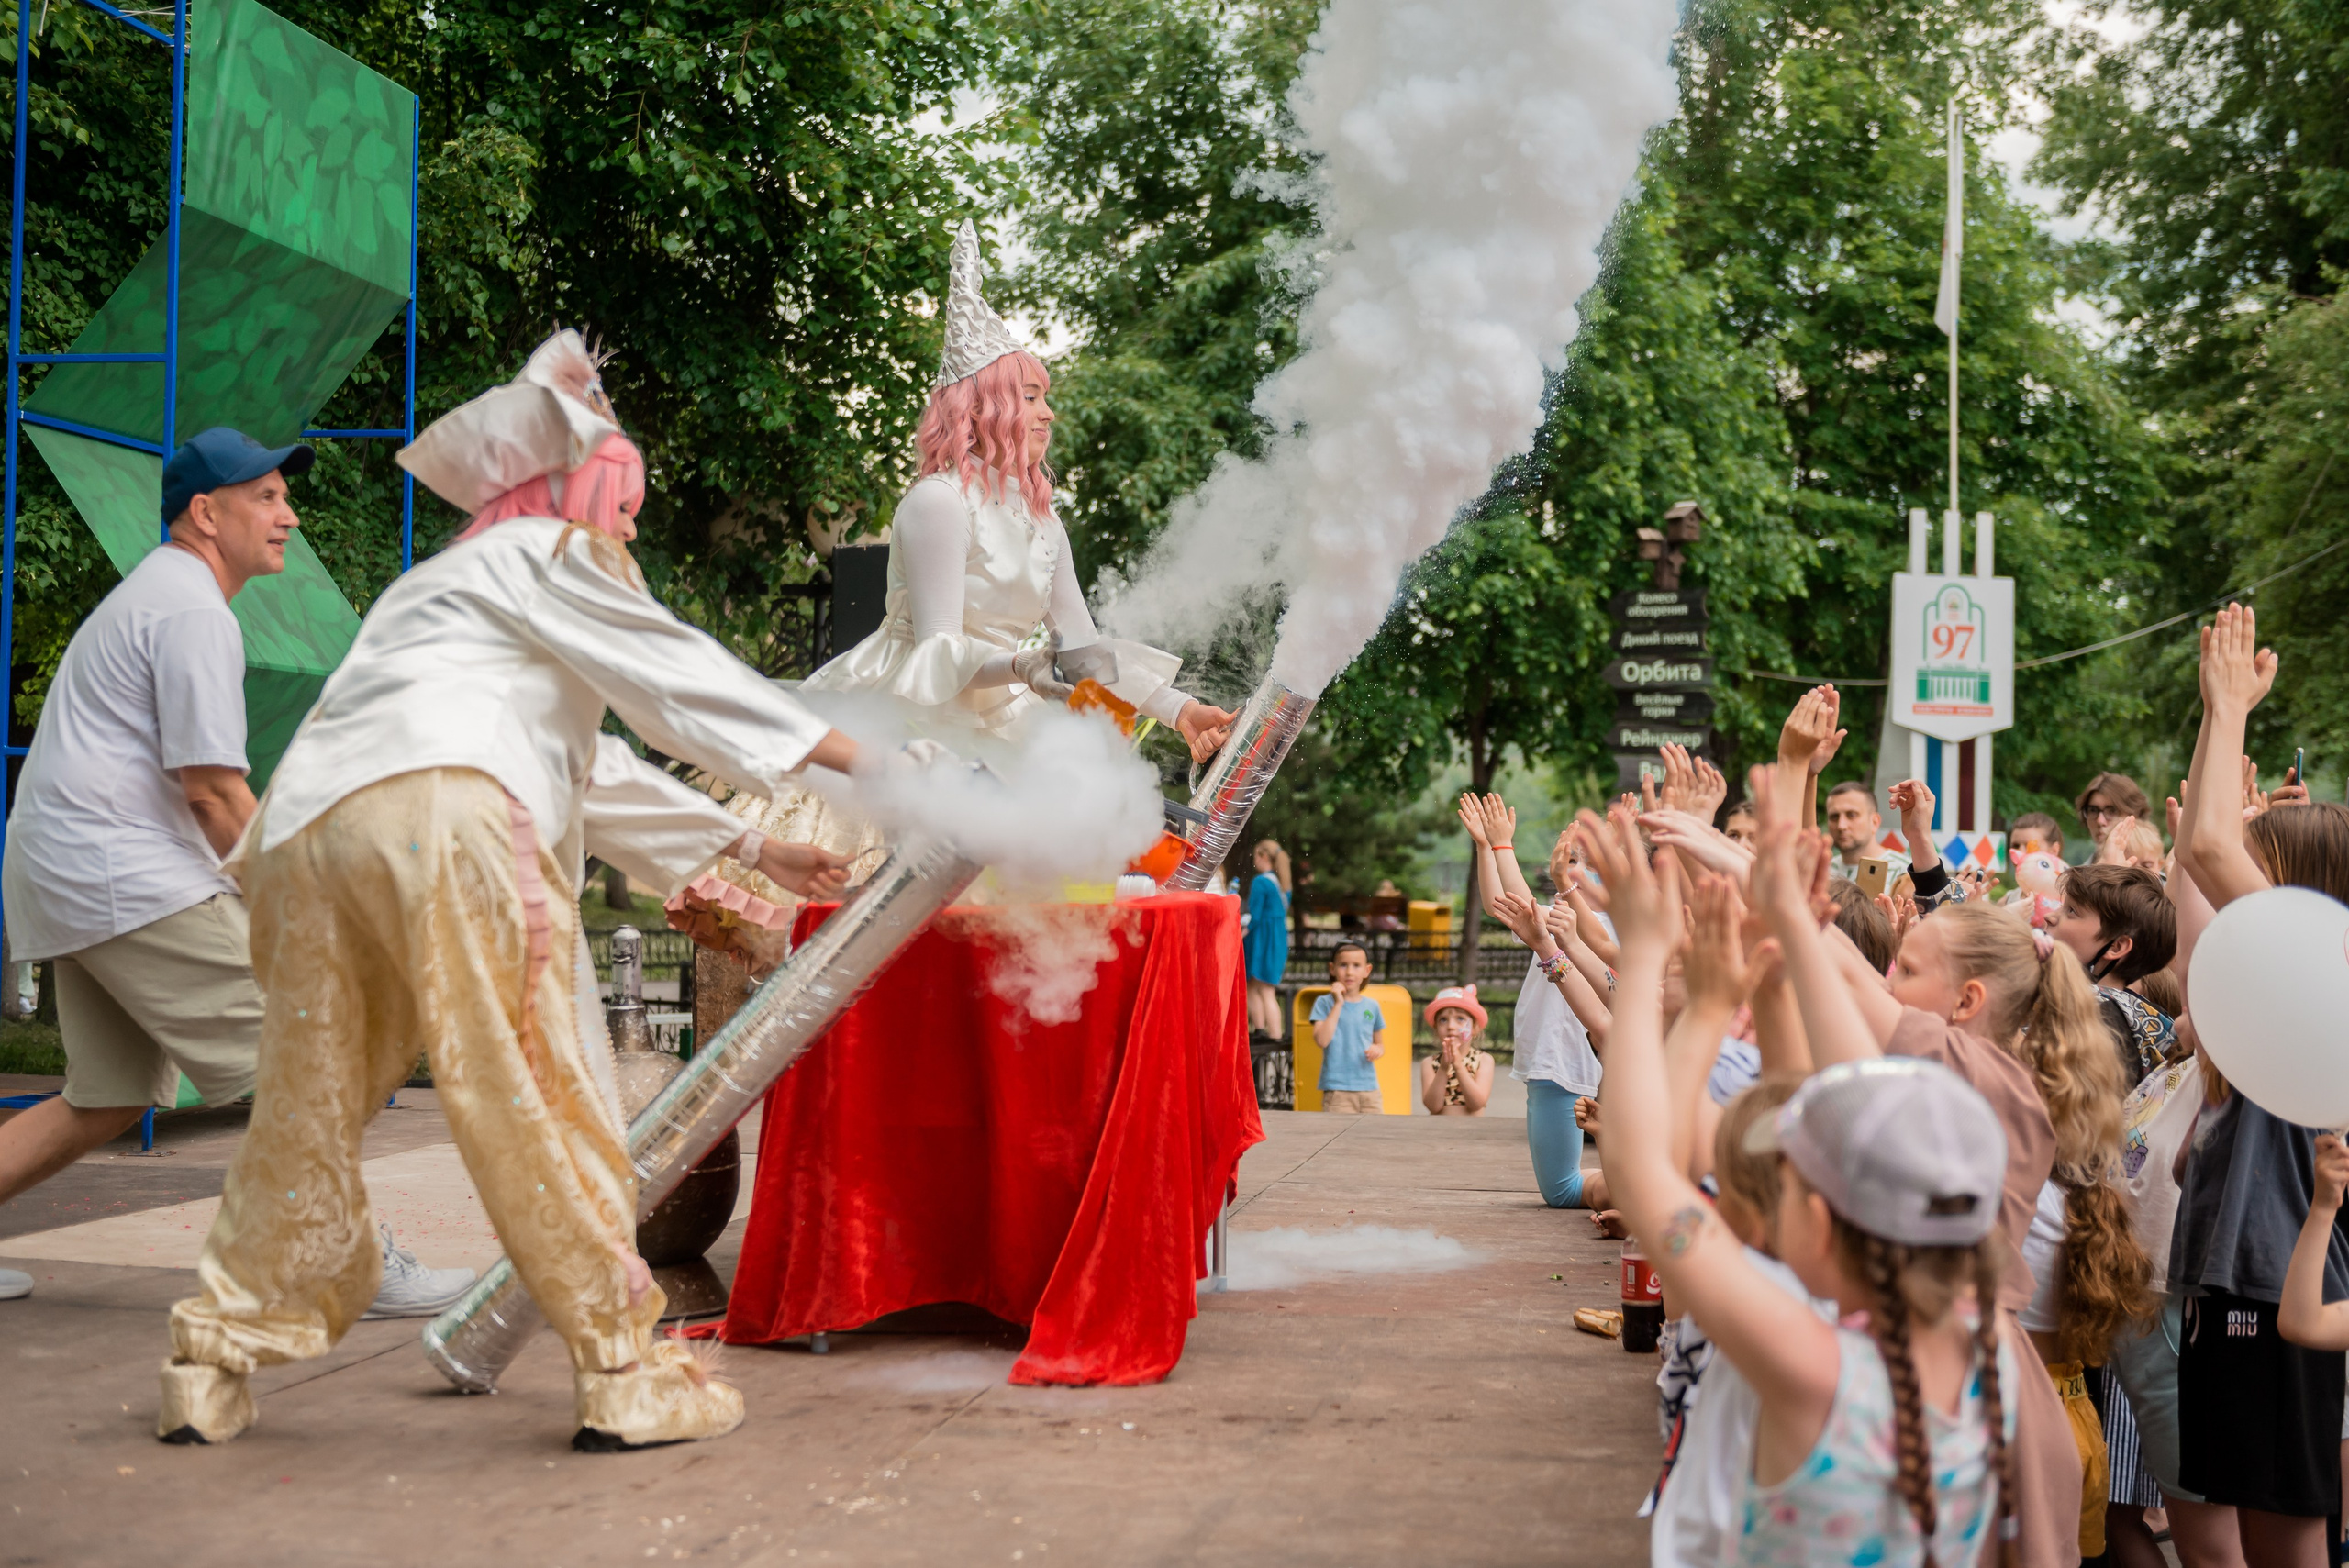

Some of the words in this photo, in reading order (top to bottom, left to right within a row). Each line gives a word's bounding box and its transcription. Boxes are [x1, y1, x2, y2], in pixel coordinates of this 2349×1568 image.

[1636, 592, 1678, 605] Колесо
[1626, 605, 1688, 618] обозрения
[1620, 631, 1660, 648] Дикий
[1663, 631, 1699, 646] поезд
[1932, 624, 1975, 660] 97
[1620, 659, 1702, 685] Орбита
[1641, 706, 1675, 719] горки
[1620, 728, 1702, 750] Рейнджер
